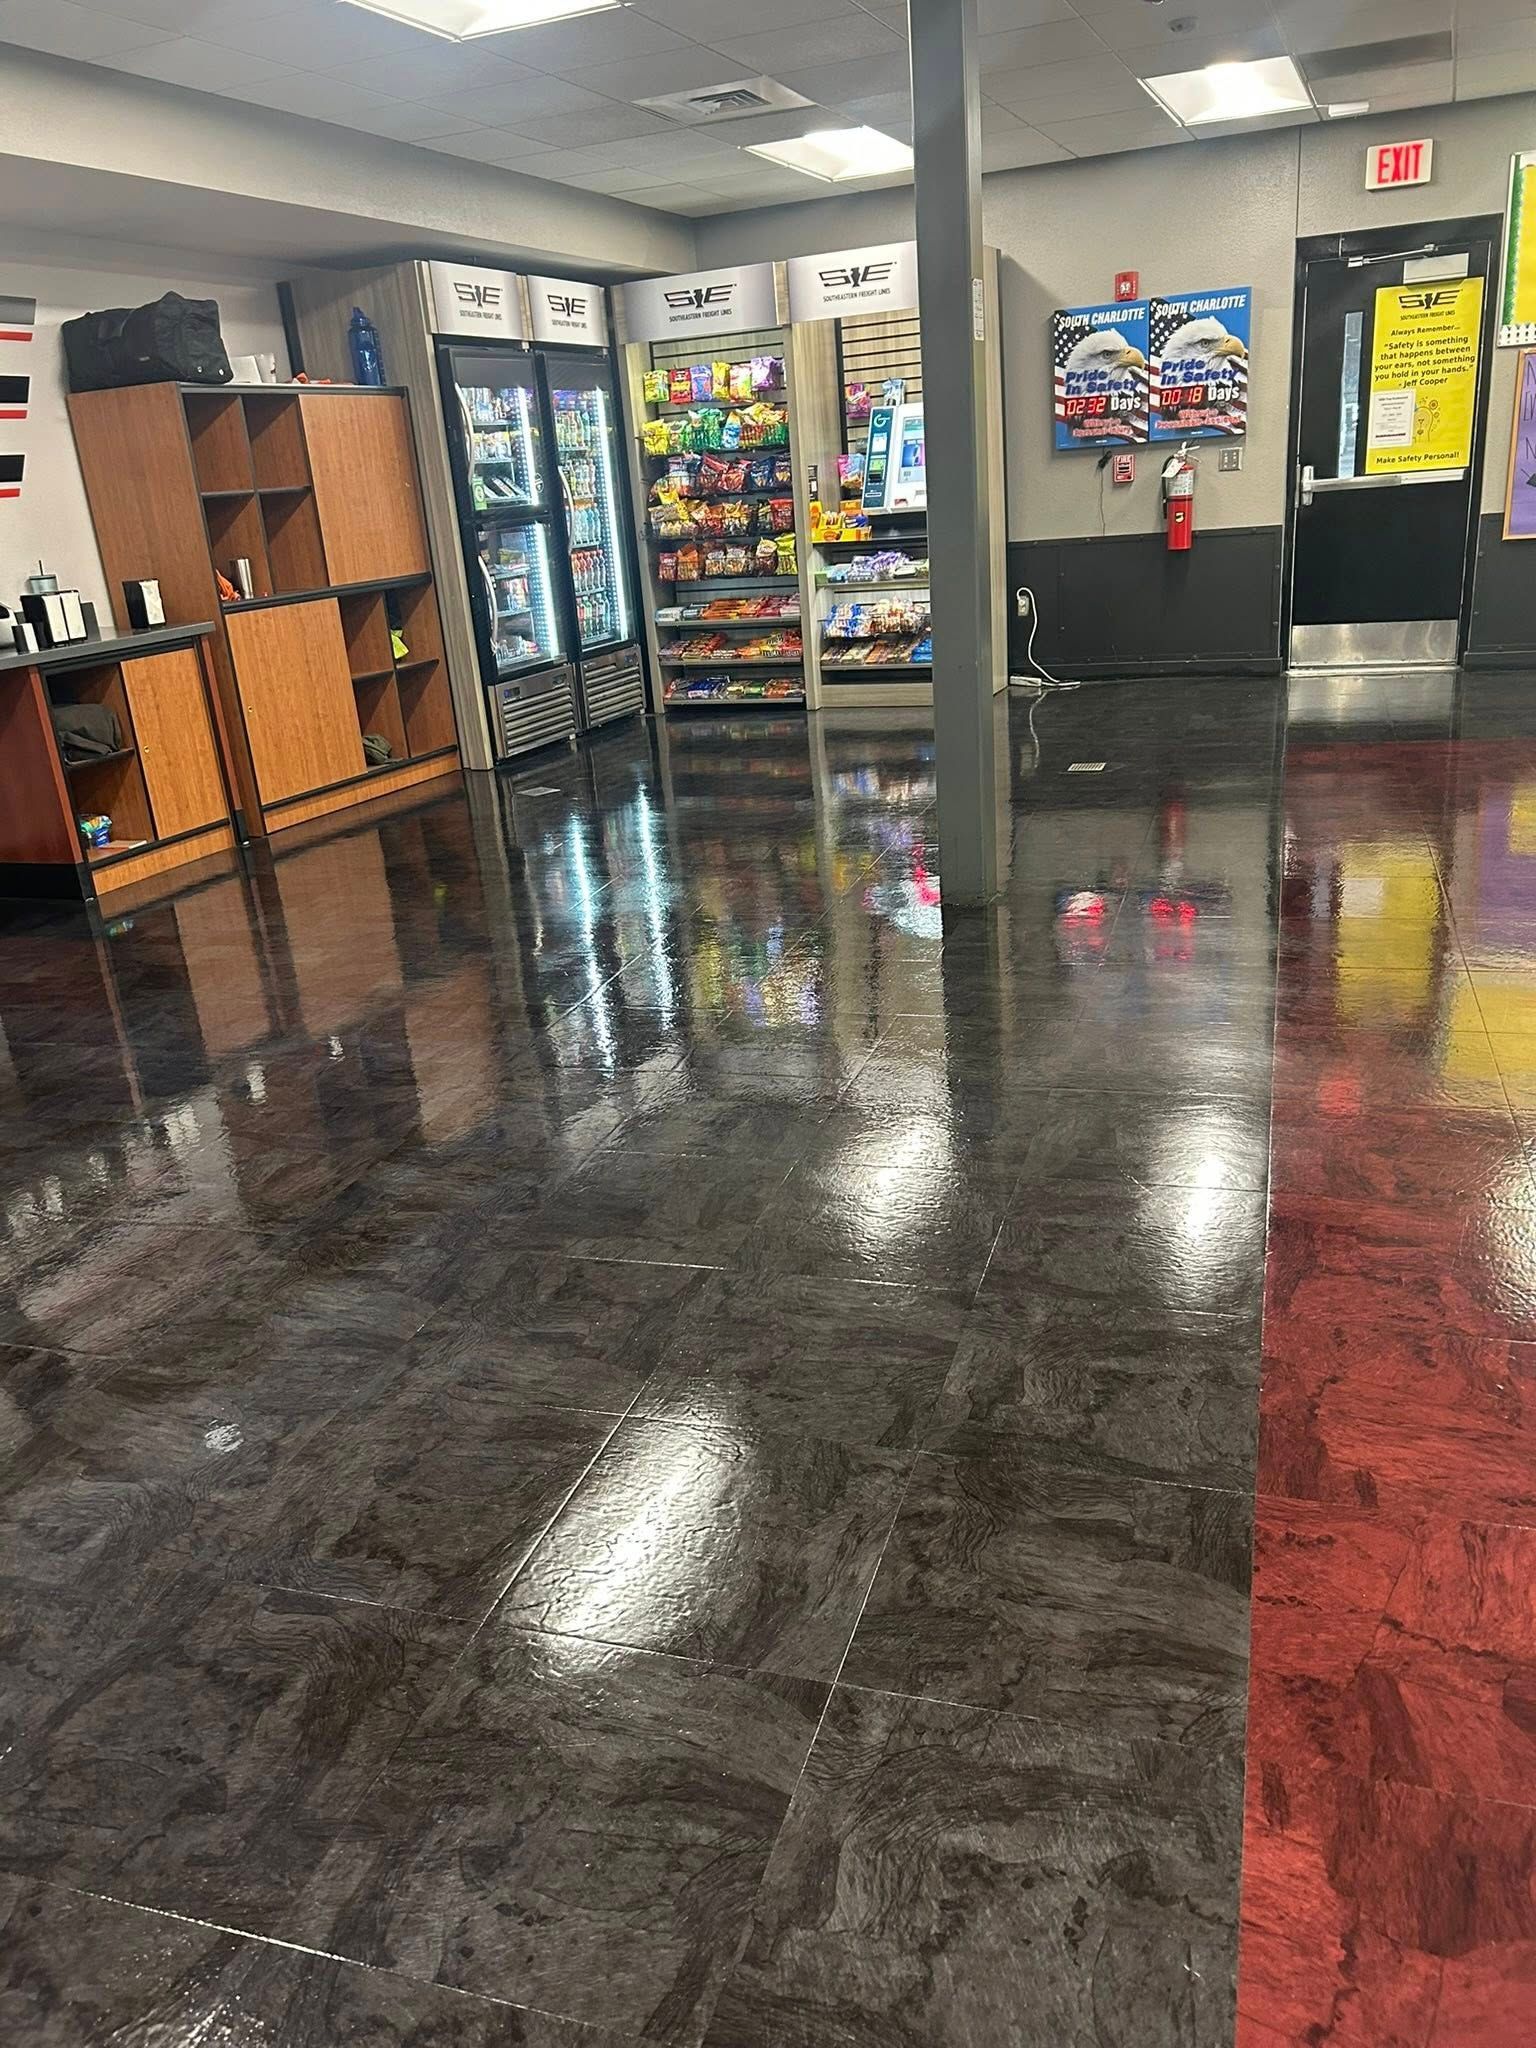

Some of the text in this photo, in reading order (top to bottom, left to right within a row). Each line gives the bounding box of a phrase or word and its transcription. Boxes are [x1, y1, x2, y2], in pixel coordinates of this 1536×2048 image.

[1377, 144, 1424, 184] EXIT
[1155, 294, 1247, 318] SOUTH CHARLOTTE
[1058, 307, 1146, 330] SOUTH CHARLOTTE
[1391, 327, 1415, 337] Always
[1416, 339, 1423, 347] is
[1425, 335, 1469, 346] something
[1380, 345, 1471, 361] that happens between
[1160, 358, 1206, 374] Pride
[1374, 354, 1476, 373] your ears, not something
[1065, 369, 1109, 384] Pride
[1183, 367, 1240, 384] Safety
[1374, 373, 1390, 382] you
[1391, 370, 1410, 379] hold
[1421, 367, 1440, 377] your
[1403, 378, 1418, 388] Jeff
[1419, 377, 1448, 388] Cooper
[1087, 378, 1140, 394] Safety
[1207, 385, 1240, 402] Days
[1110, 396, 1142, 412] Days
[1376, 451, 1460, 464] Make Safety Personal!
